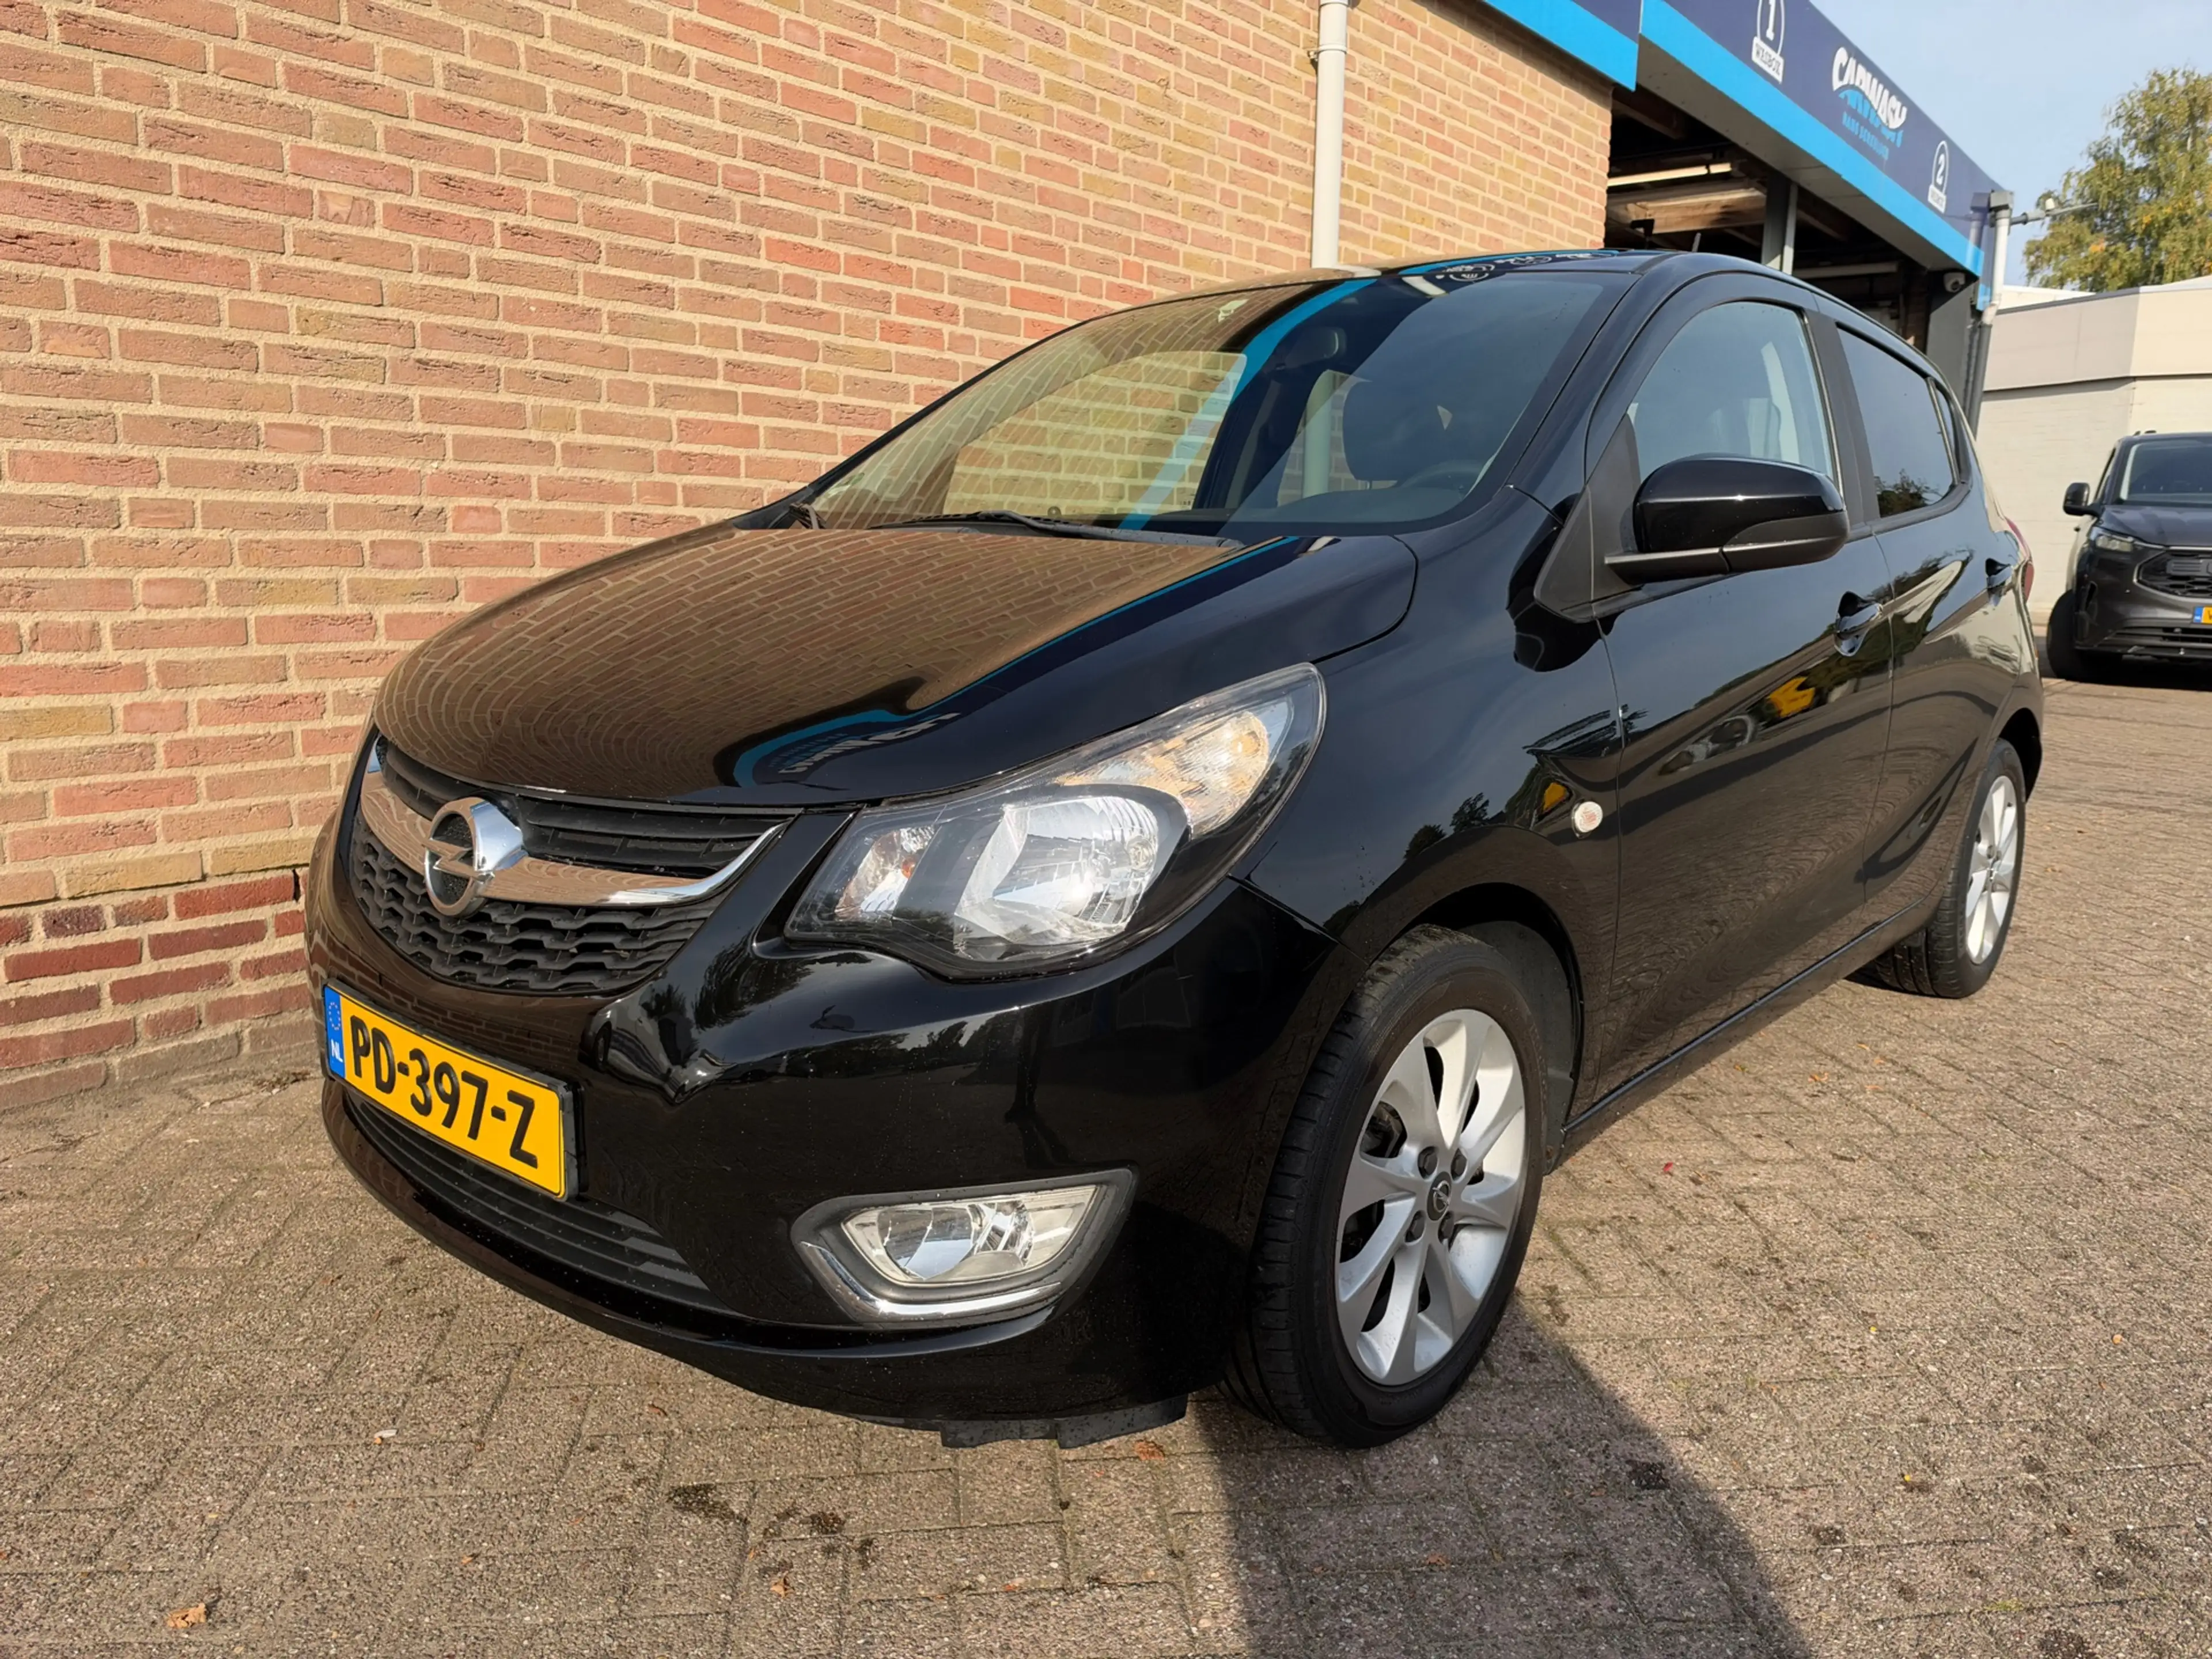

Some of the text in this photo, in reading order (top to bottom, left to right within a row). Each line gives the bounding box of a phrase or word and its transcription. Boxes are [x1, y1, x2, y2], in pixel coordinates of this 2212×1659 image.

[1832, 46, 1908, 130] CARWASH
[1936, 153, 1945, 185] 2
[331, 1039, 344, 1063] NL
[350, 1014, 539, 1169] PD-397-Z
